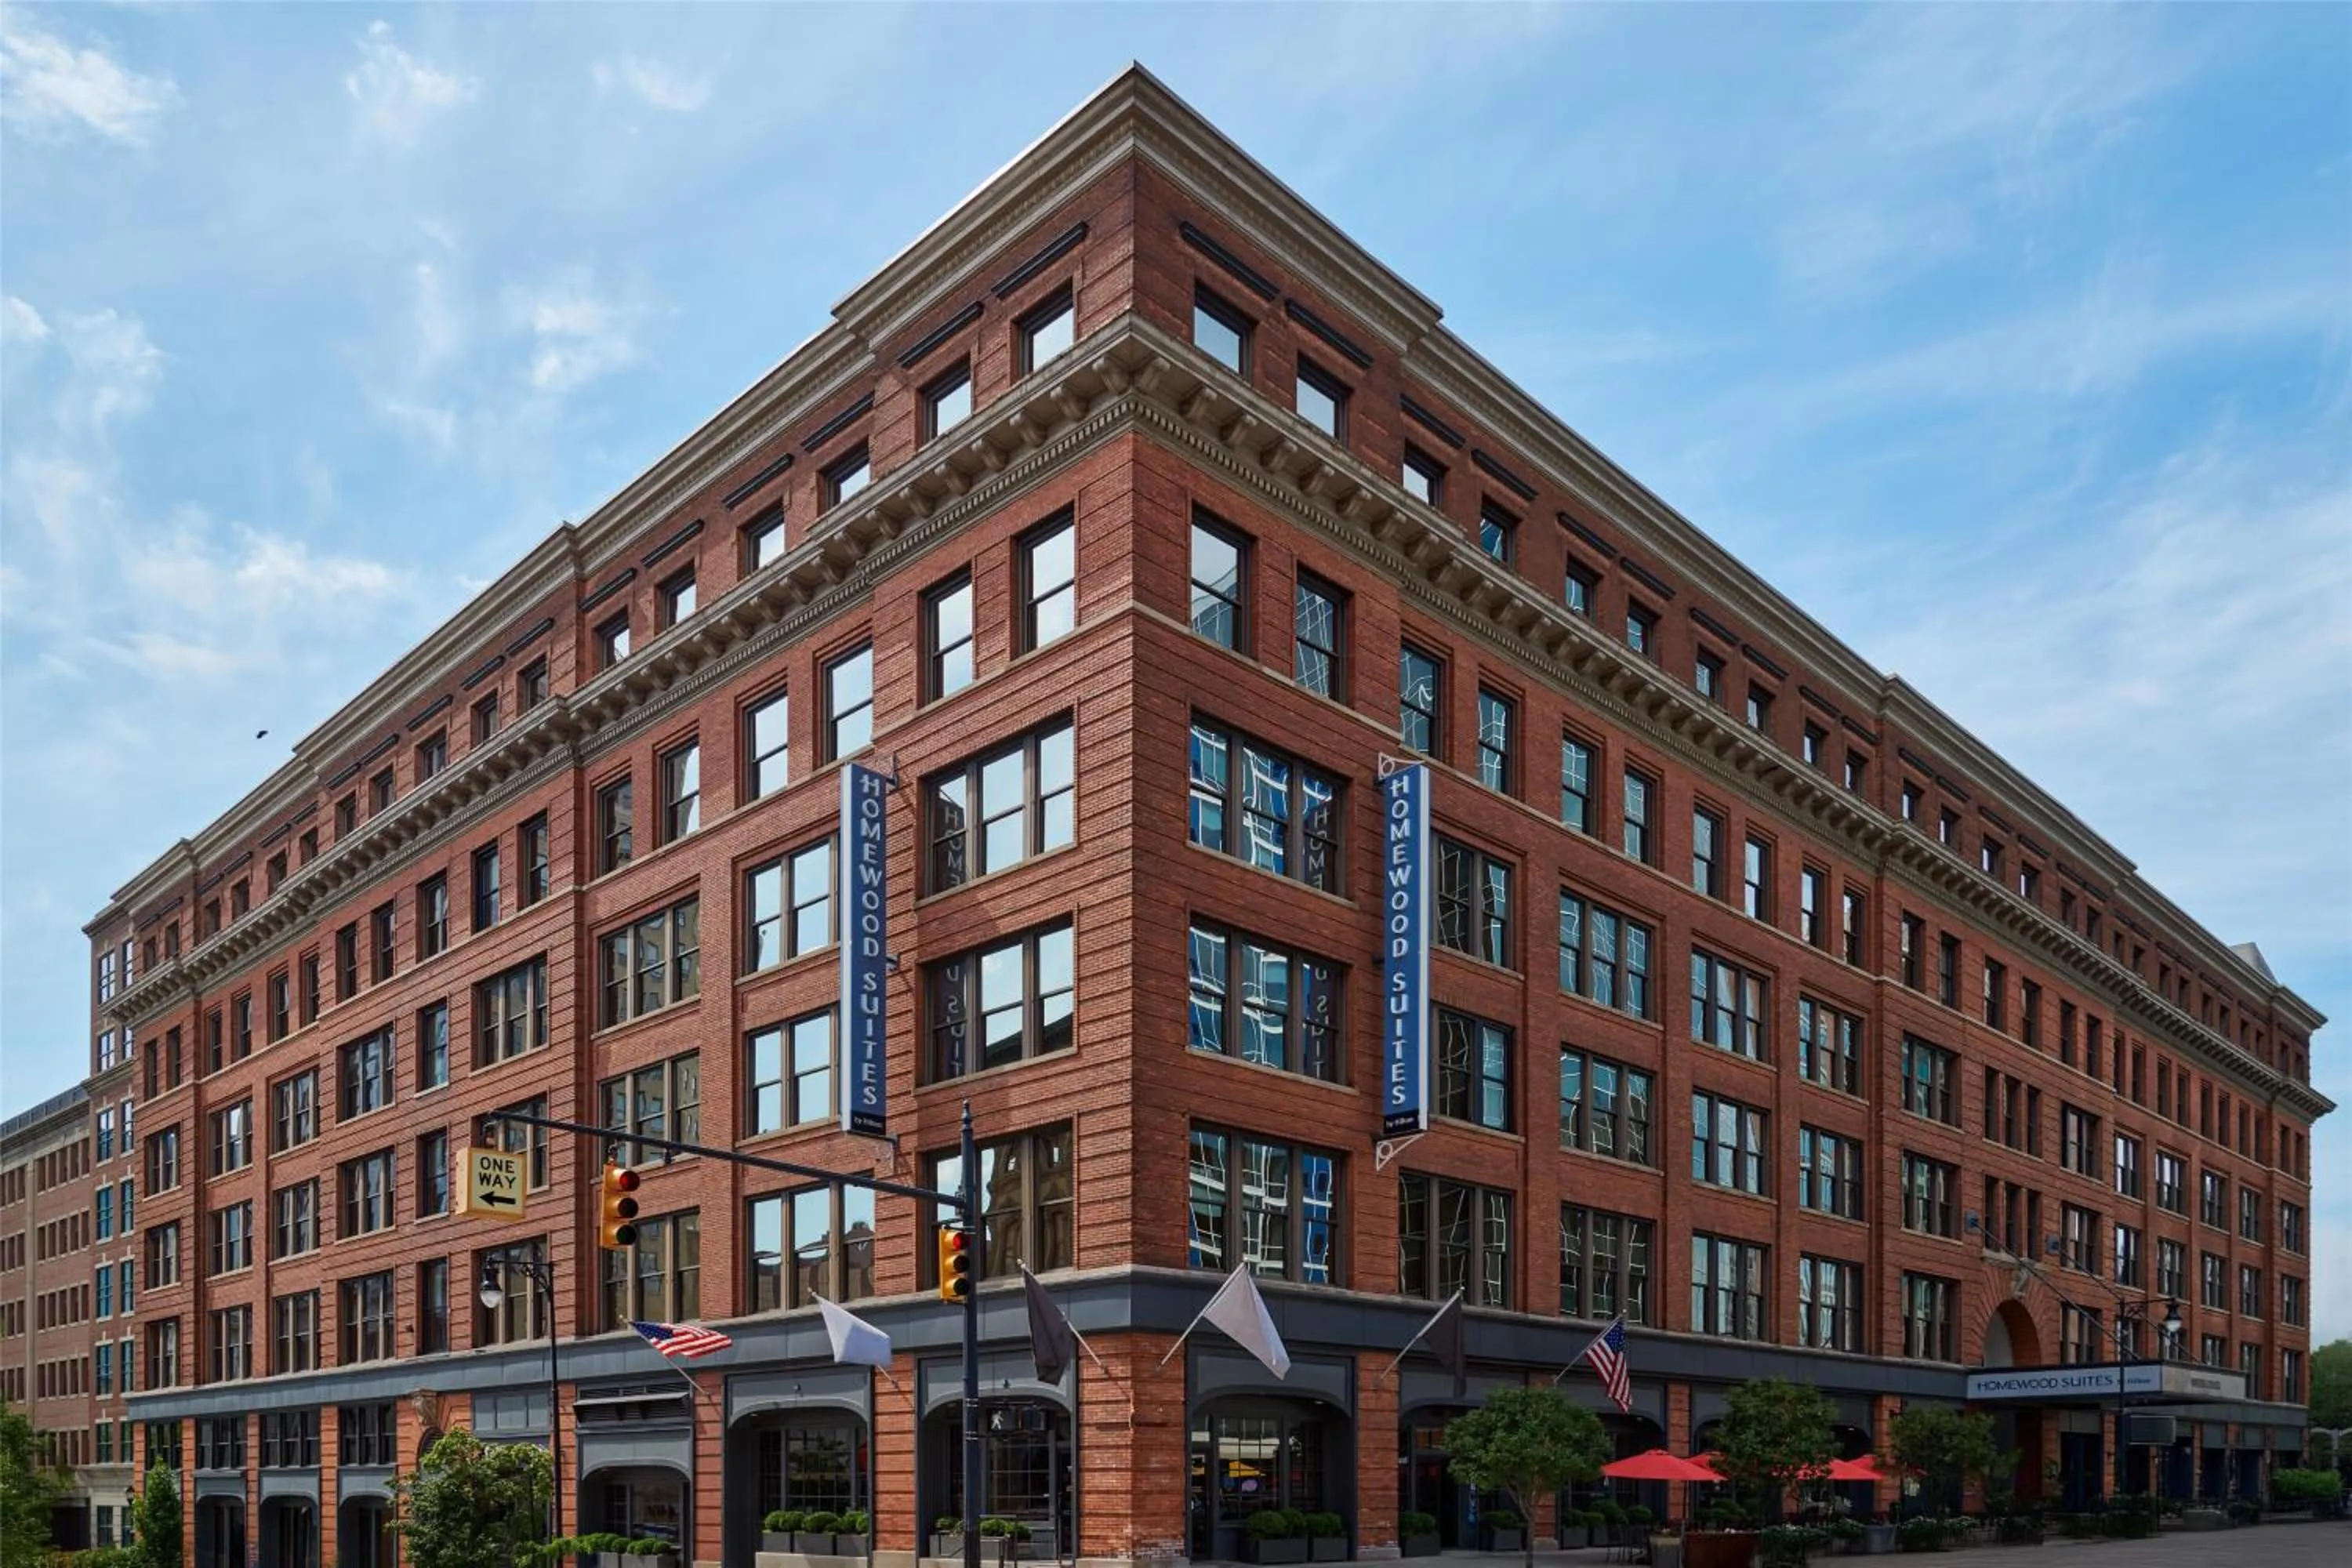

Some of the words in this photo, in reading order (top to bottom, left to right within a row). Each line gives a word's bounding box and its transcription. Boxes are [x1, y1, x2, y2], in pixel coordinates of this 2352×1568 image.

[858, 775, 883, 957] HOMEWOOD
[1388, 775, 1411, 958] HOMEWOOD
[859, 971, 880, 1105] SUITES
[1389, 971, 1409, 1105] SUITES
[478, 1172, 517, 1189] WAY
[480, 1156, 515, 1174] ONE
[1976, 1377, 2058, 1392] HOMEWOOD
[2061, 1374, 2114, 1388] SUITES
